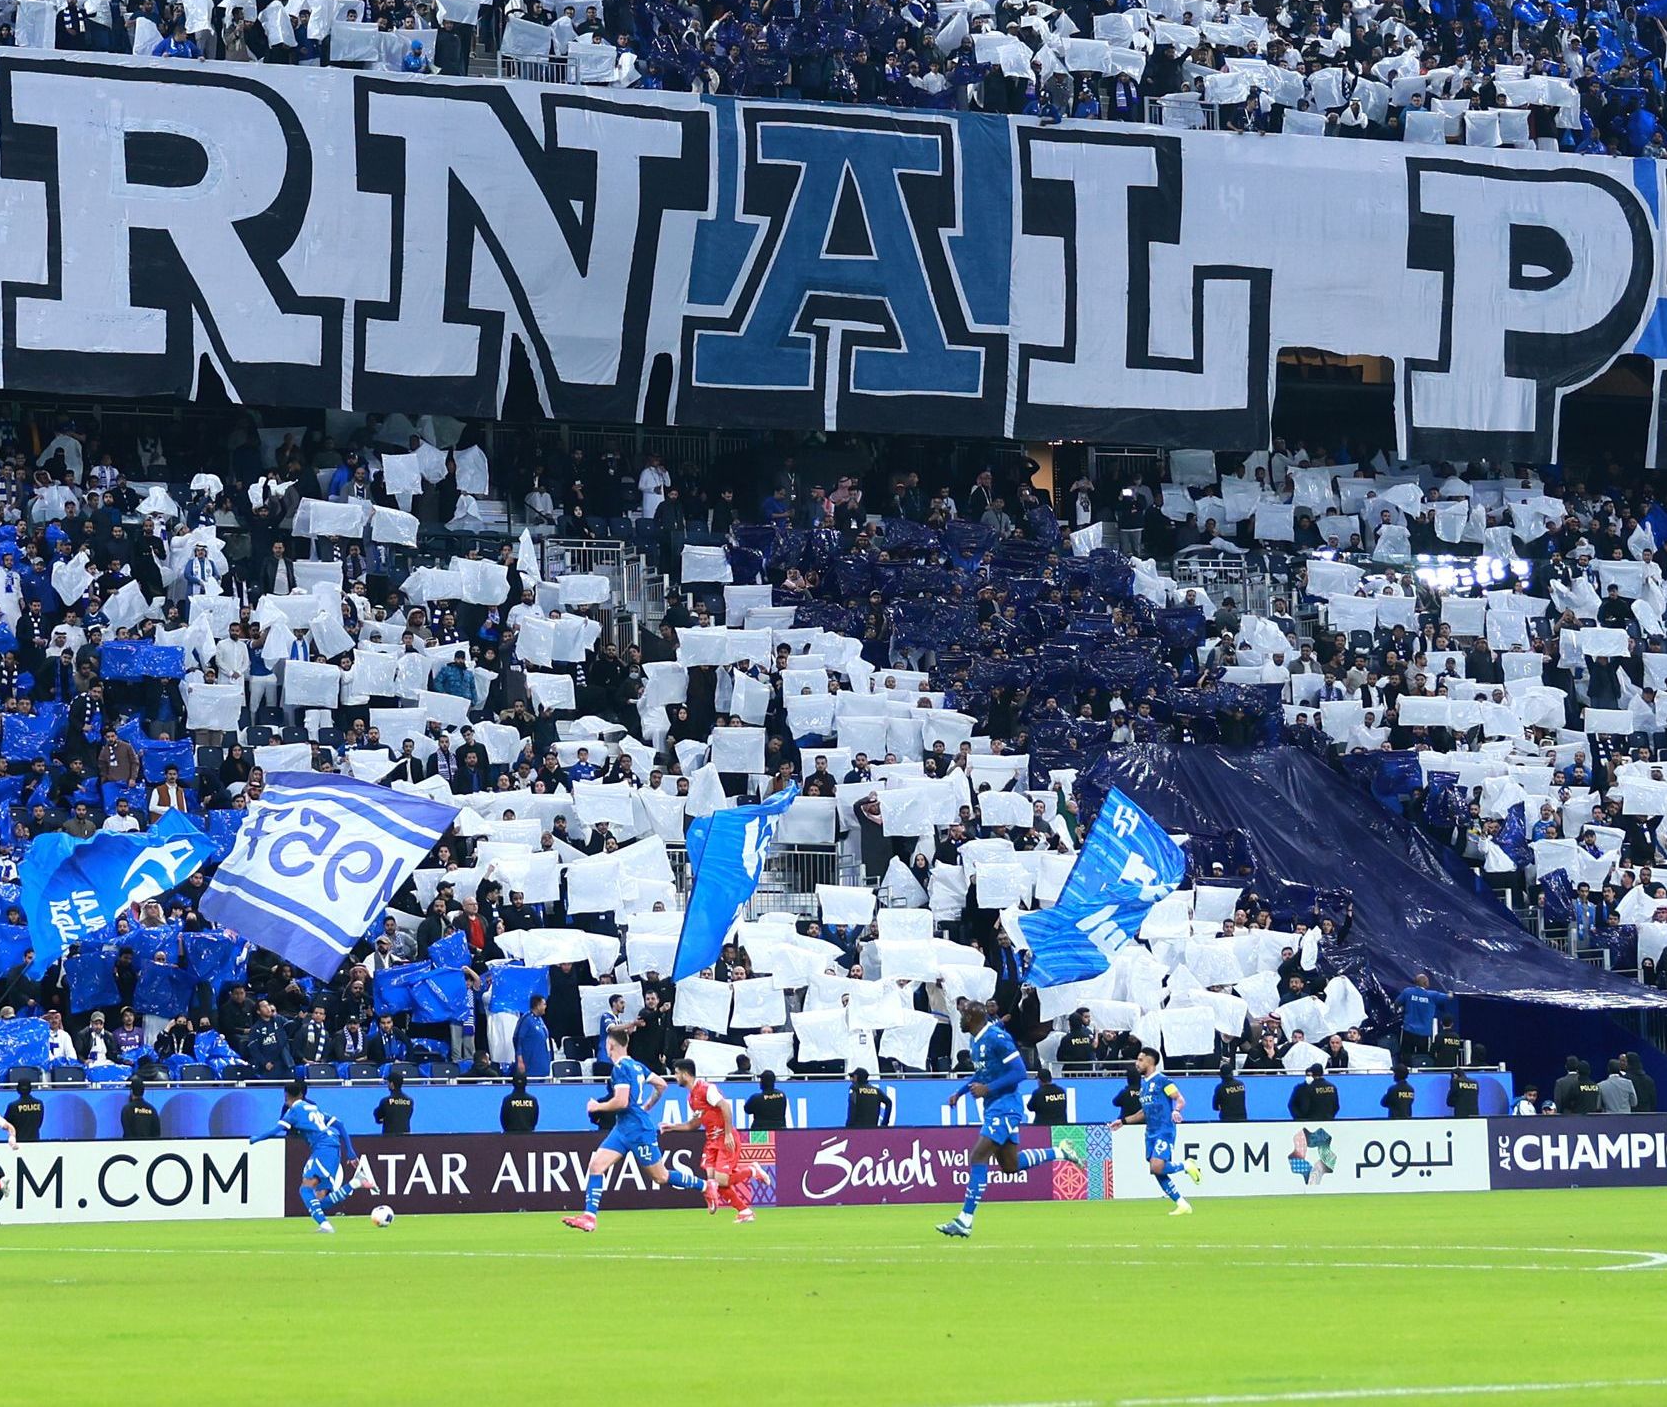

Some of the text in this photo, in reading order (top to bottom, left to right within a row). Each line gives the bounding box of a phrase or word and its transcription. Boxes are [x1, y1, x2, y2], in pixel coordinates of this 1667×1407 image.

[389, 1097, 411, 1105] Police
[511, 1100, 533, 1108] POLICE
[1045, 1094, 1066, 1103] POLICE
[17, 1104, 41, 1112] POLICE
[134, 1107, 152, 1115] Police
[637, 1145, 651, 1157] 22
[1356, 1130, 1453, 1178] نيوم
[1499, 1135, 1512, 1171] AFC
[1184, 1141, 1270, 1174] EOM
[801, 1136, 937, 1199] Saudi
[953, 1170, 970, 1184] to
